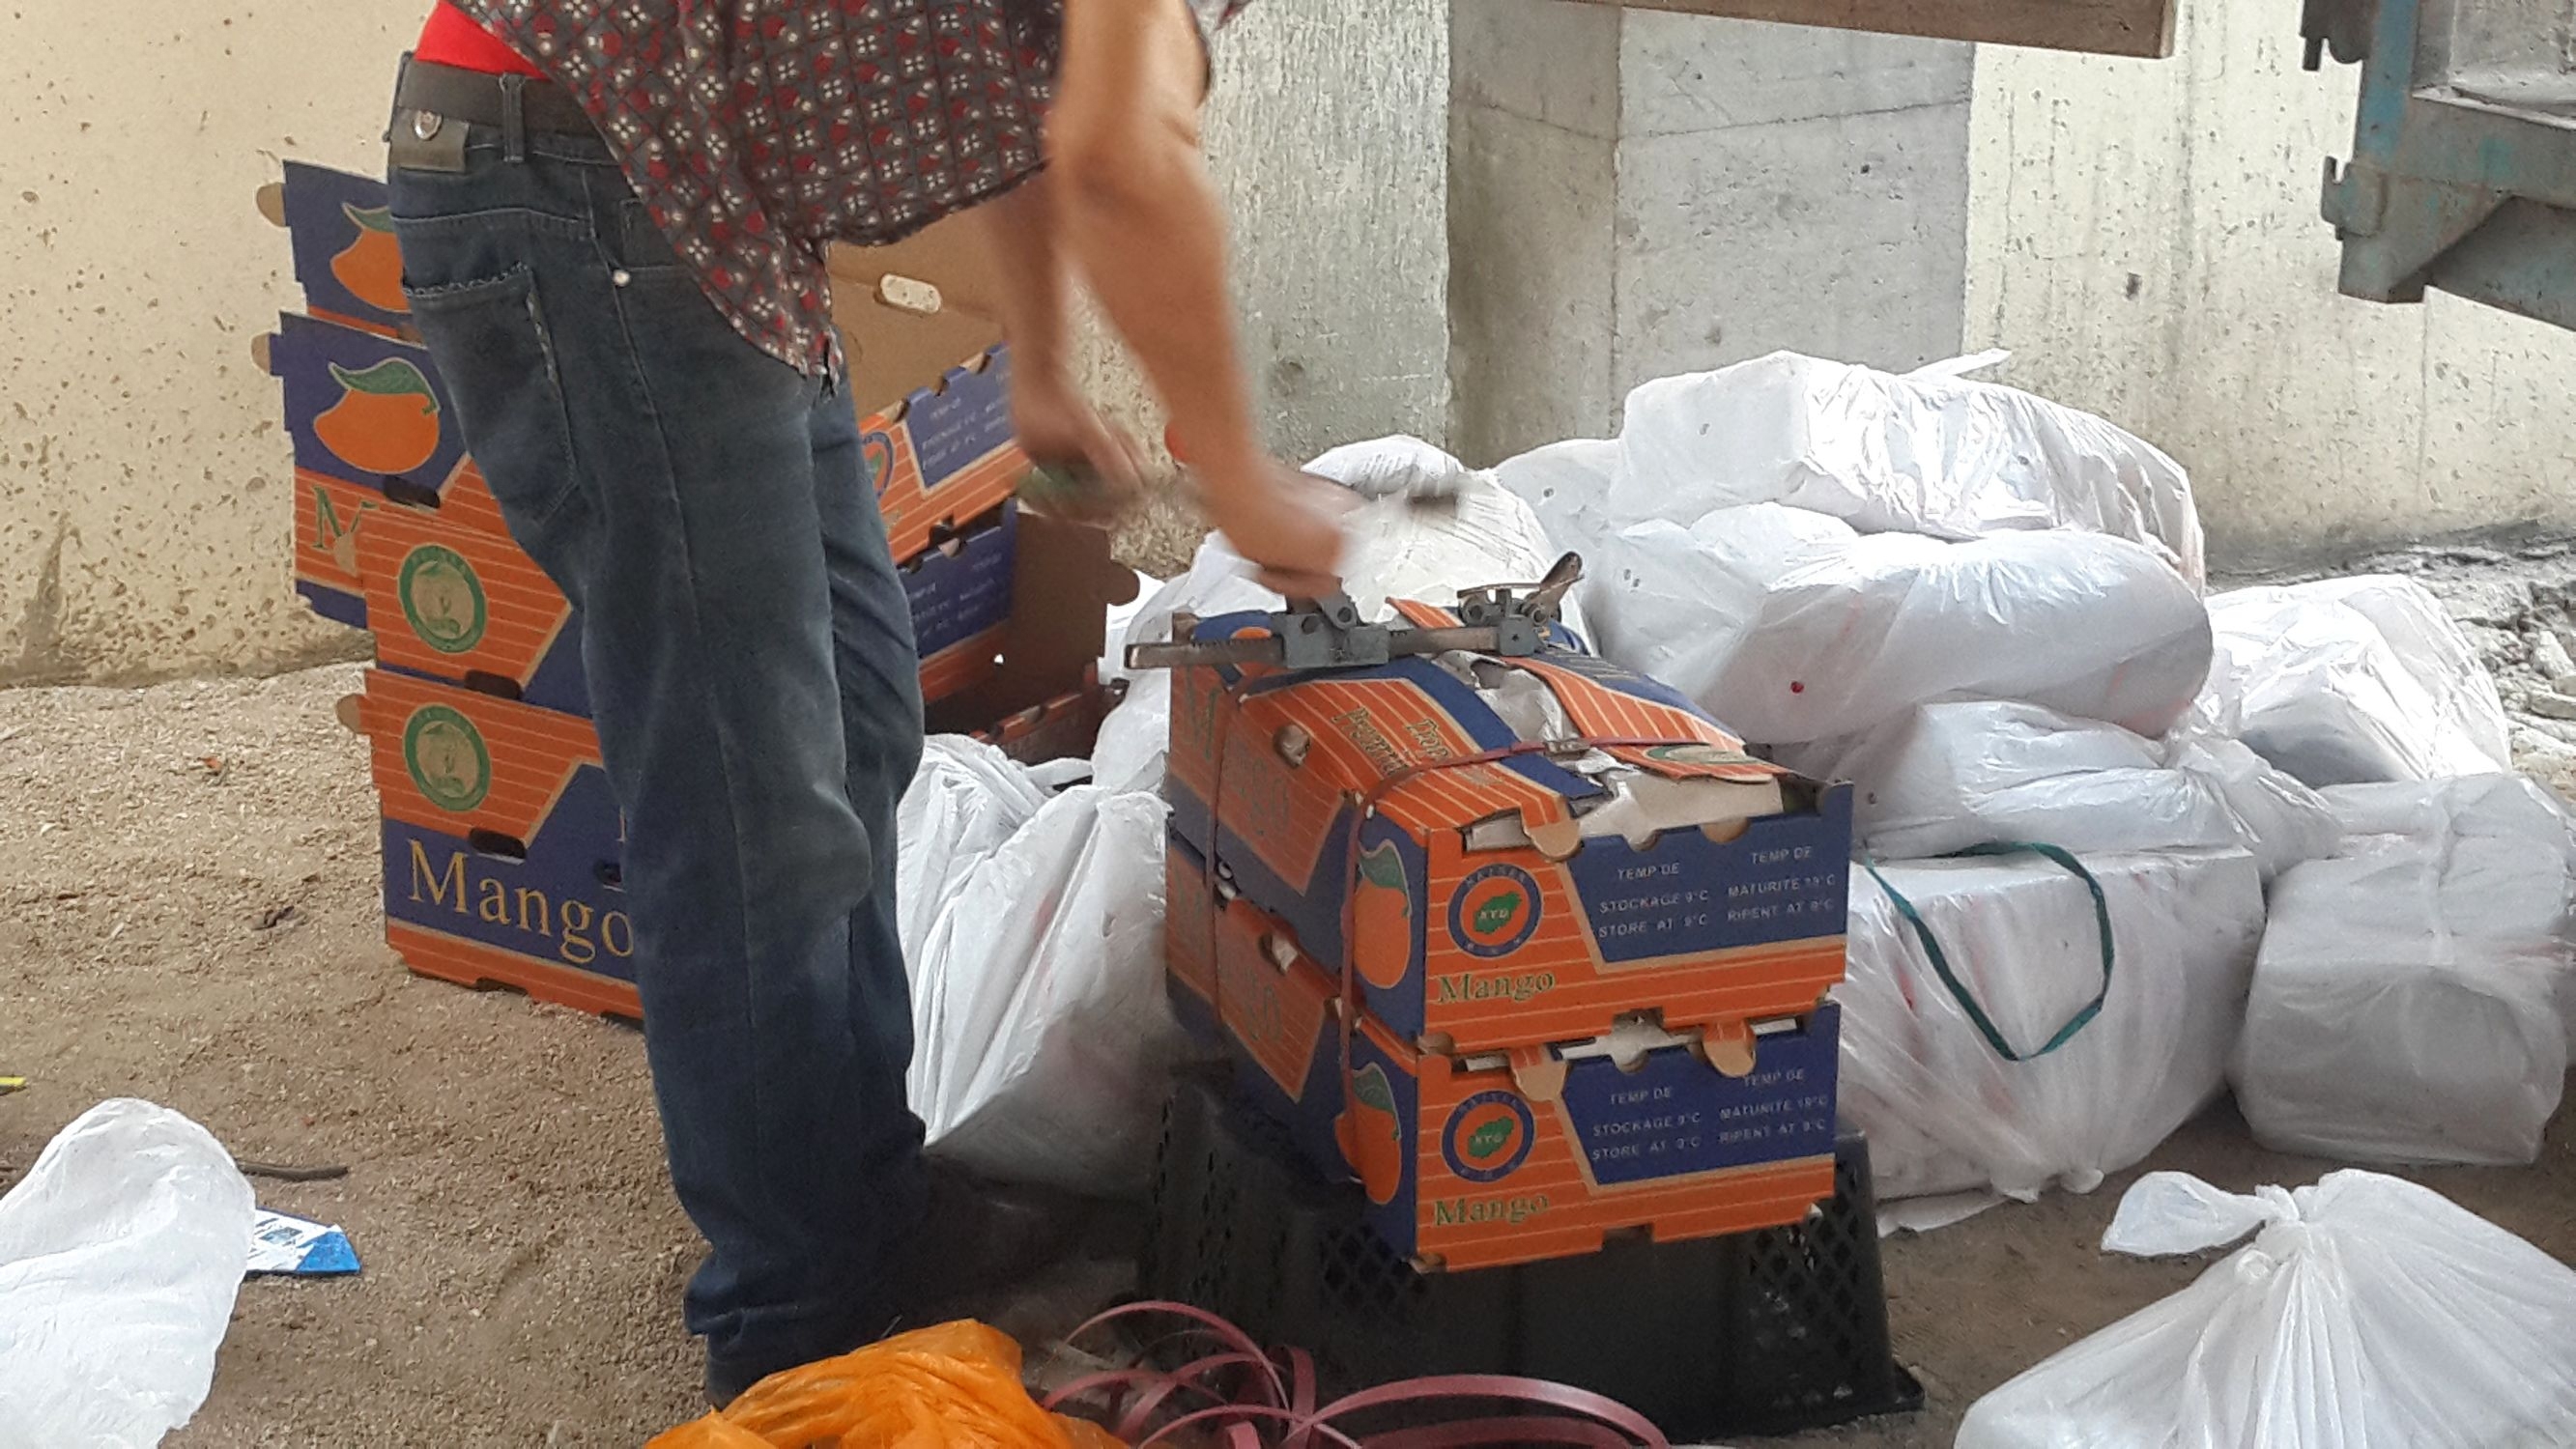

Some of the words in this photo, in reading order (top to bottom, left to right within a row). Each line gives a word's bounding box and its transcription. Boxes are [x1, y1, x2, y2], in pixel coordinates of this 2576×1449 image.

[1750, 848, 1789, 866] TEMP
[1792, 845, 1813, 861] DE
[1617, 865, 1657, 880] TEMP
[1660, 862, 1680, 876] DE
[1727, 877, 1801, 898] MATURITE
[408, 838, 635, 964] Mango
[1599, 892, 1681, 915] STOCKAGE
[1597, 920, 1648, 939] STORE
[1655, 917, 1674, 932] AT
[1437, 971, 1556, 1004] Mango
[1743, 1069, 1782, 1087] TEMP
[1609, 1089, 1649, 1106] TEMP
[1652, 1086, 1673, 1100] DE
[1591, 1114, 1674, 1137] STOCKAGE
[1590, 1143, 1641, 1161] STORE
[1434, 1194, 1550, 1227] Mango
